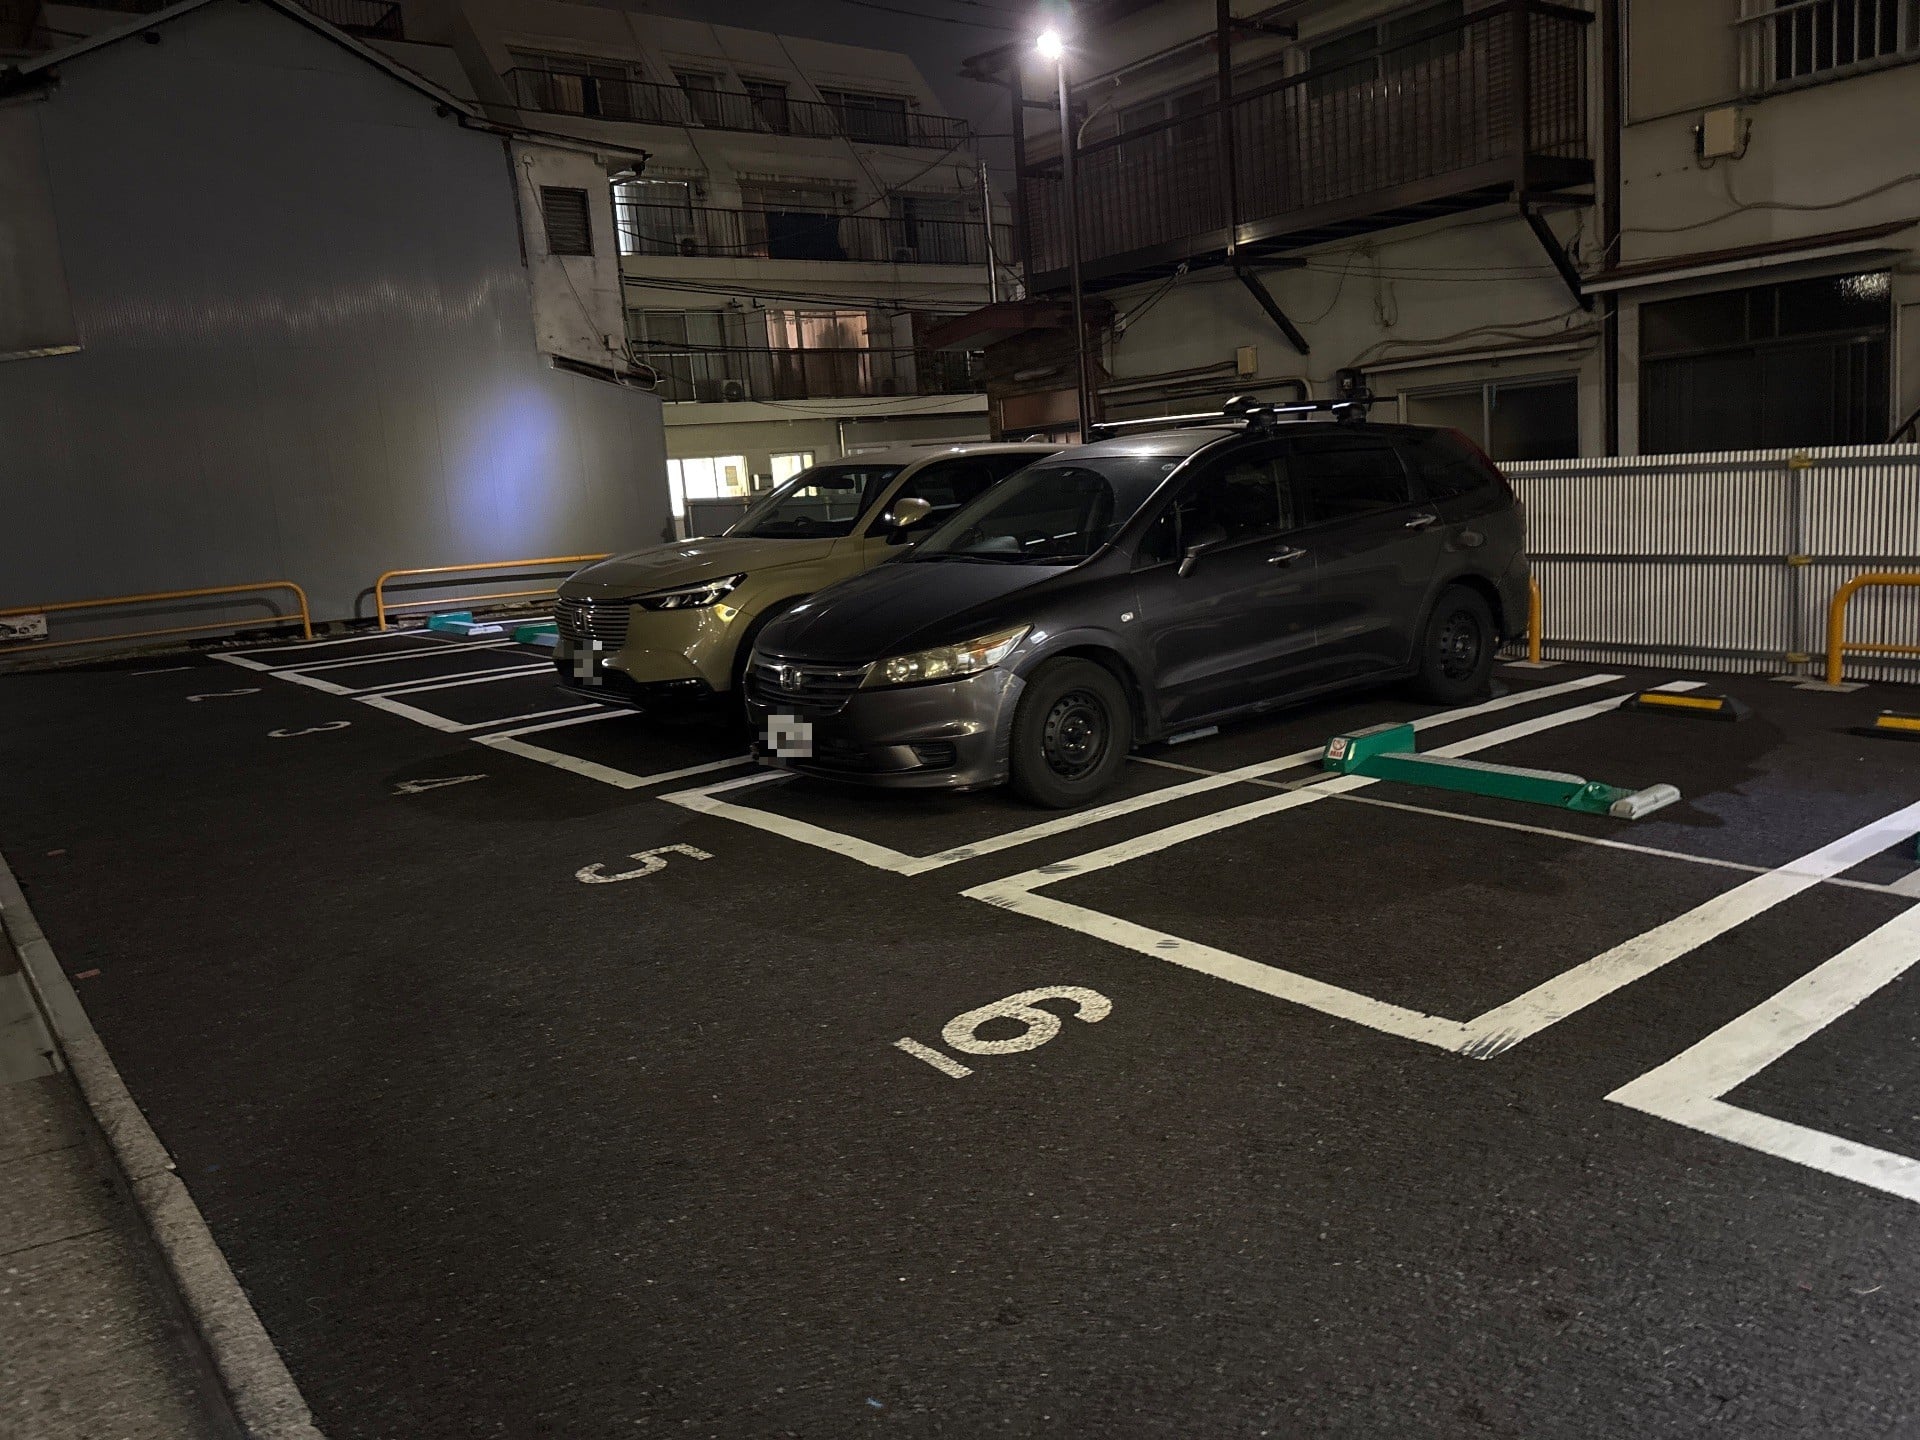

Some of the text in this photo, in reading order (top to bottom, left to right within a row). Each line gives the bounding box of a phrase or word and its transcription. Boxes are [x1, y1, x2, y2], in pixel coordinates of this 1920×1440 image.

[266, 720, 353, 738] 3
[391, 773, 490, 797] 4
[573, 842, 717, 885] 5
[940, 984, 1113, 1056] 6
